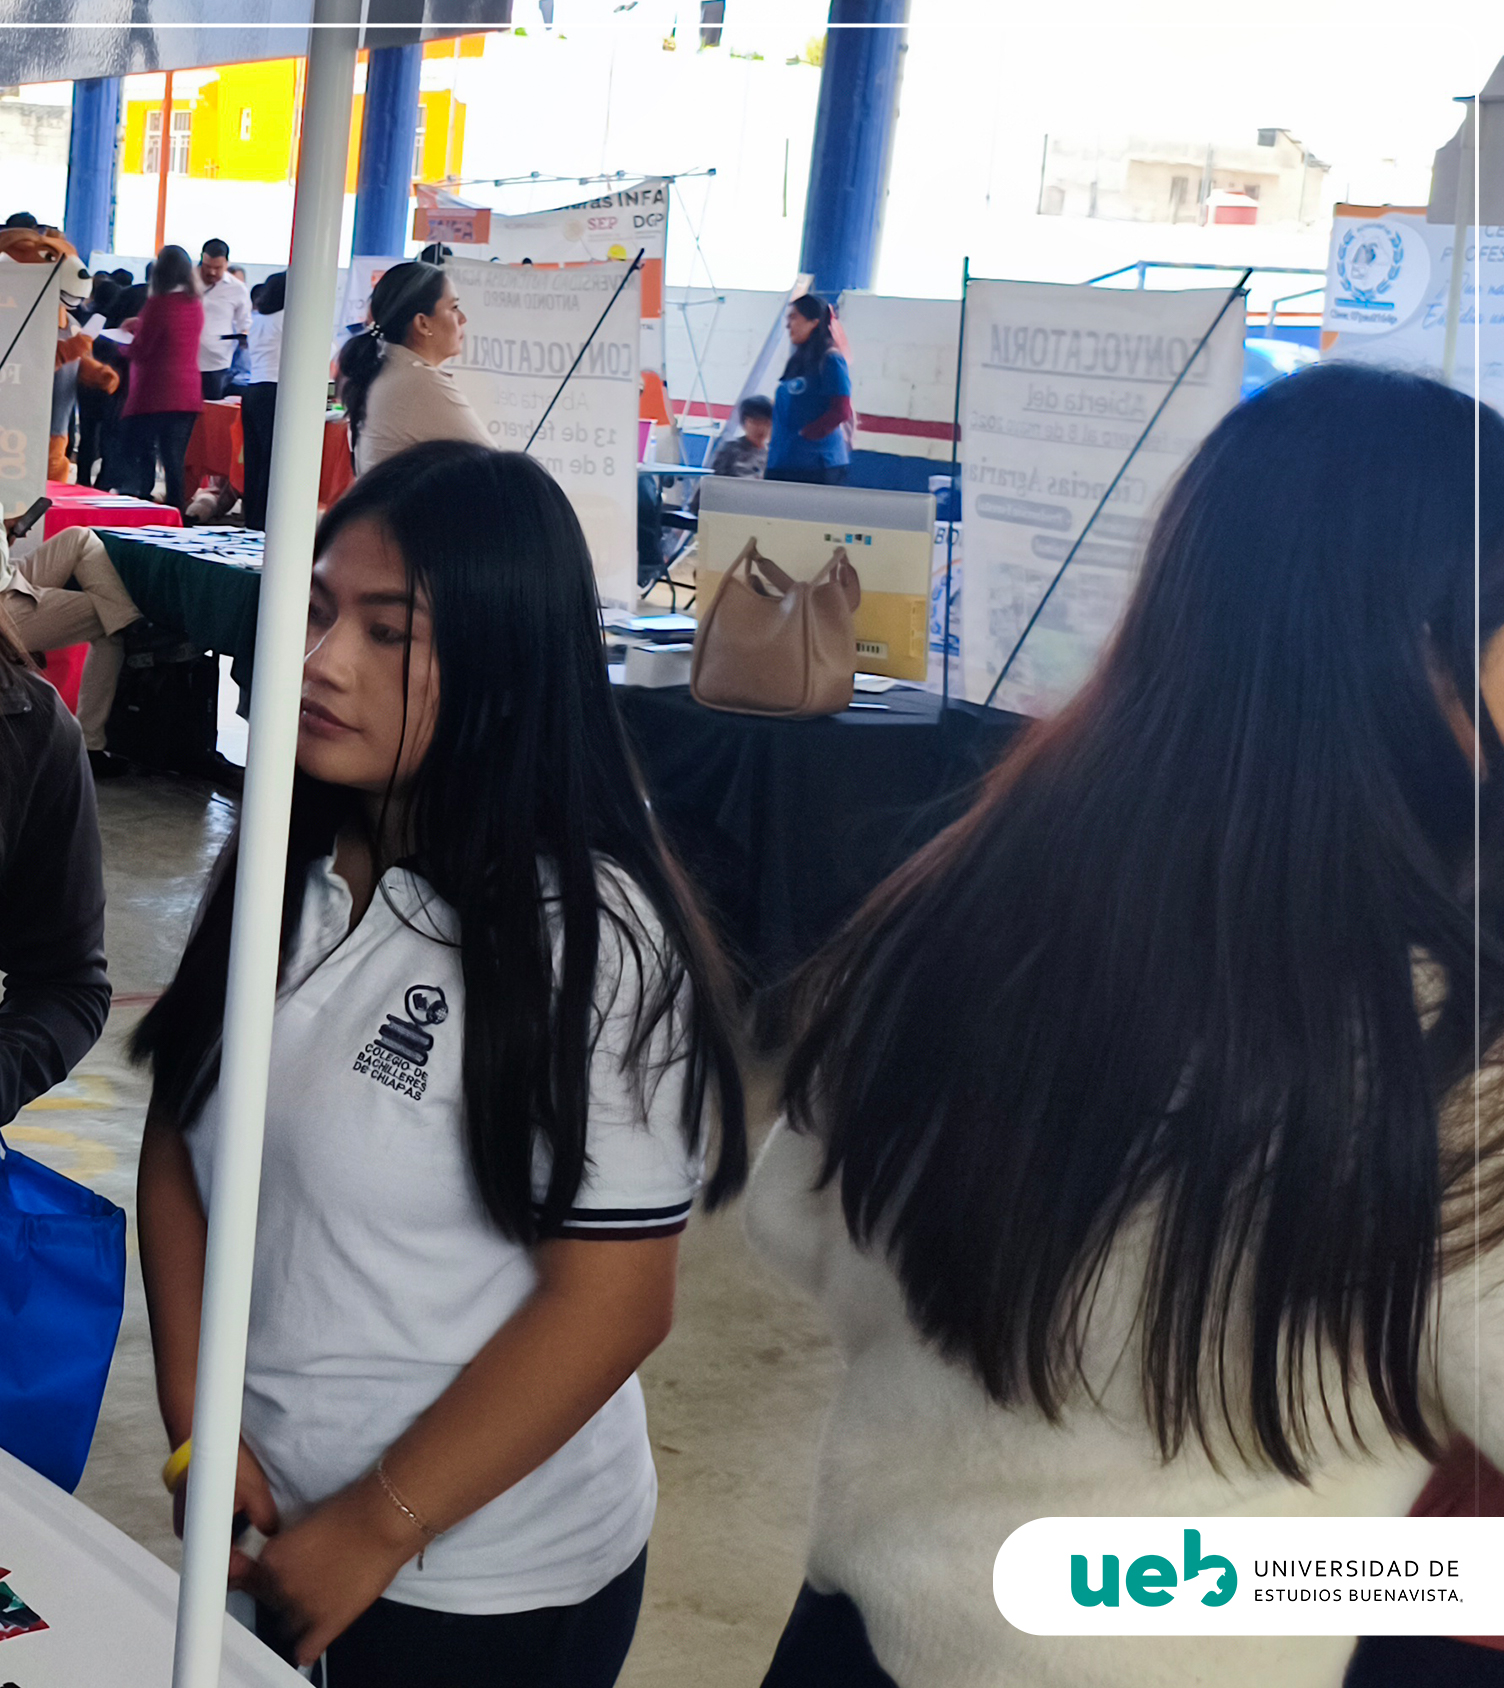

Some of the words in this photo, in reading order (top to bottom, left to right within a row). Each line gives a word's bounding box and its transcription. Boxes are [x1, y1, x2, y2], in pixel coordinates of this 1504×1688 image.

[587, 216, 618, 230] SEP
[353, 1061, 369, 1074] DE
[371, 1070, 422, 1101] CHIAPAS
[357, 1052, 427, 1092] BACHILLERES
[365, 1043, 410, 1071] COLEGIO
[414, 1068, 429, 1081] DE
